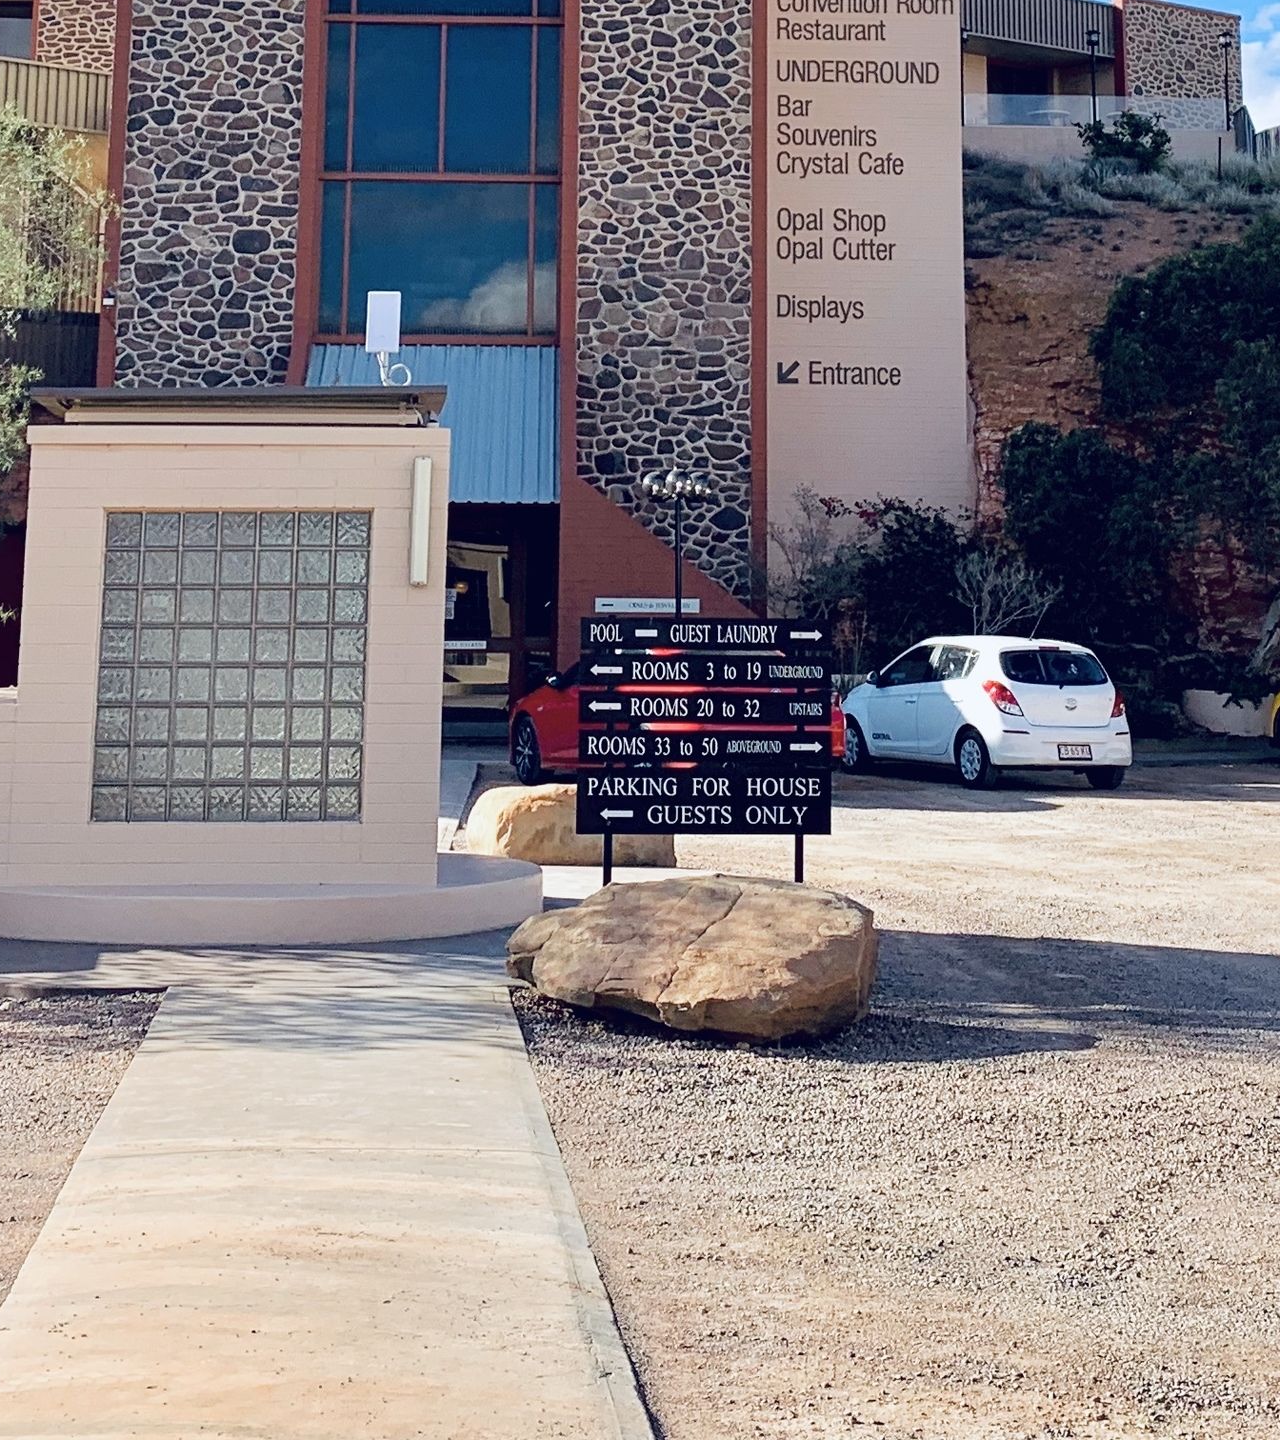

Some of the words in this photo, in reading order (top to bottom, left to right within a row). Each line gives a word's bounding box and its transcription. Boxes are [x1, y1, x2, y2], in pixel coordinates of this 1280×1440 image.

[777, 18, 886, 41] Restaurant
[777, 59, 940, 84] UNDERGROUND
[777, 94, 812, 117] Bar
[777, 122, 877, 147] Souvenirs
[777, 151, 849, 179] Crystal
[858, 151, 904, 176] Cafe
[777, 208, 823, 236] Opal
[833, 208, 886, 237] Shop
[777, 236, 823, 264] Opal
[833, 237, 896, 261] Cutter
[777, 294, 864, 324] Displays
[809, 360, 901, 386] Entrance
[590, 623, 623, 643] POOL
[670, 624, 711, 643] GUEST
[717, 624, 778, 644] LAUNDRY
[631, 661, 689, 681] ROOMS
[706, 662, 714, 680] 3
[723, 663, 737, 680] to
[746, 662, 761, 680] 19
[768, 665, 823, 679] UNDERGROUND
[630, 697, 688, 717] ROOMS
[696, 698, 714, 718] 20
[722, 700, 735, 718] to
[743, 699, 760, 718] 32
[789, 703, 823, 716] UPSTAIRS
[587, 736, 646, 755] ROOMS
[654, 737, 670, 755] 33
[679, 739, 693, 756] to
[701, 737, 718, 756] 50
[726, 740, 782, 754] ABOVEGROUND
[587, 777, 677, 796] PARKING
[692, 777, 731, 796] FOR
[746, 778, 821, 797] HOUSE
[647, 805, 732, 824] GUESTS
[745, 805, 808, 825] ONLY
